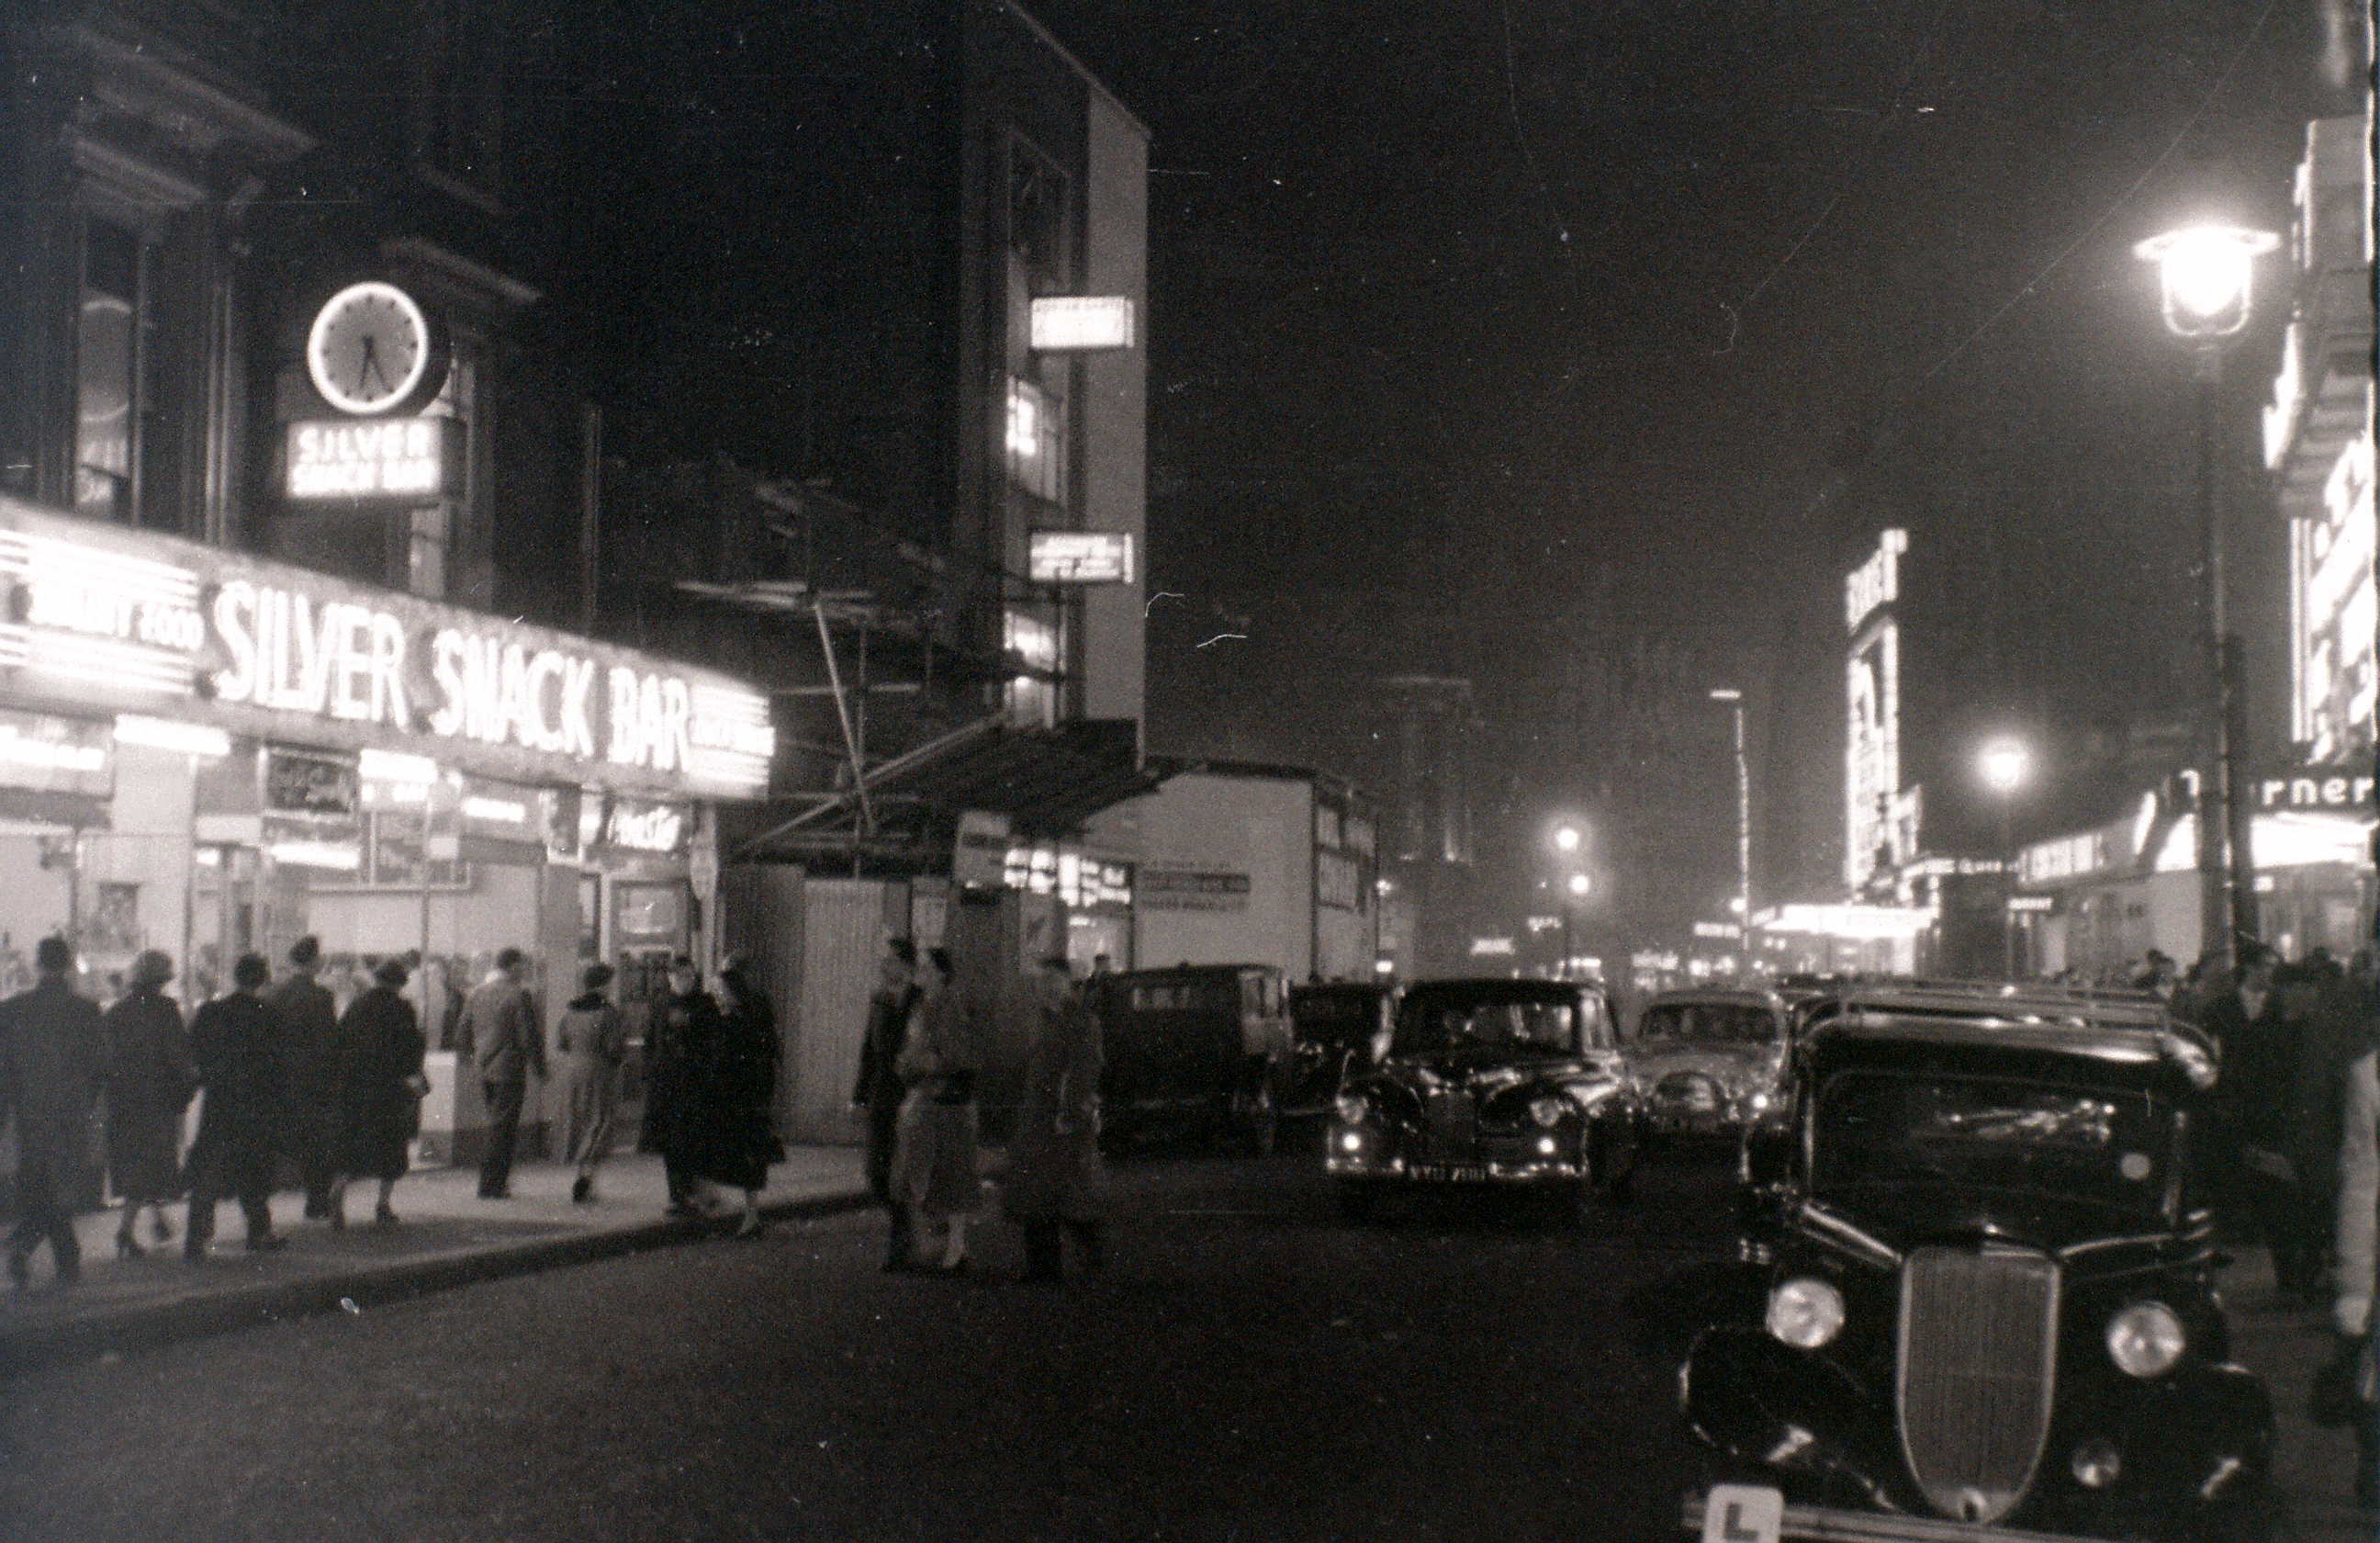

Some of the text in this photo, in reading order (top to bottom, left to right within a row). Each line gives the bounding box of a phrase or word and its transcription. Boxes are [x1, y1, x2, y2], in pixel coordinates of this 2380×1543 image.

[298, 422, 432, 462] SILVER
[214, 580, 410, 734] SILVER
[429, 628, 596, 762] SNACK
[608, 668, 691, 772] BAR
[2249, 777, 2375, 805] rner
[1723, 1502, 1760, 1542] L
